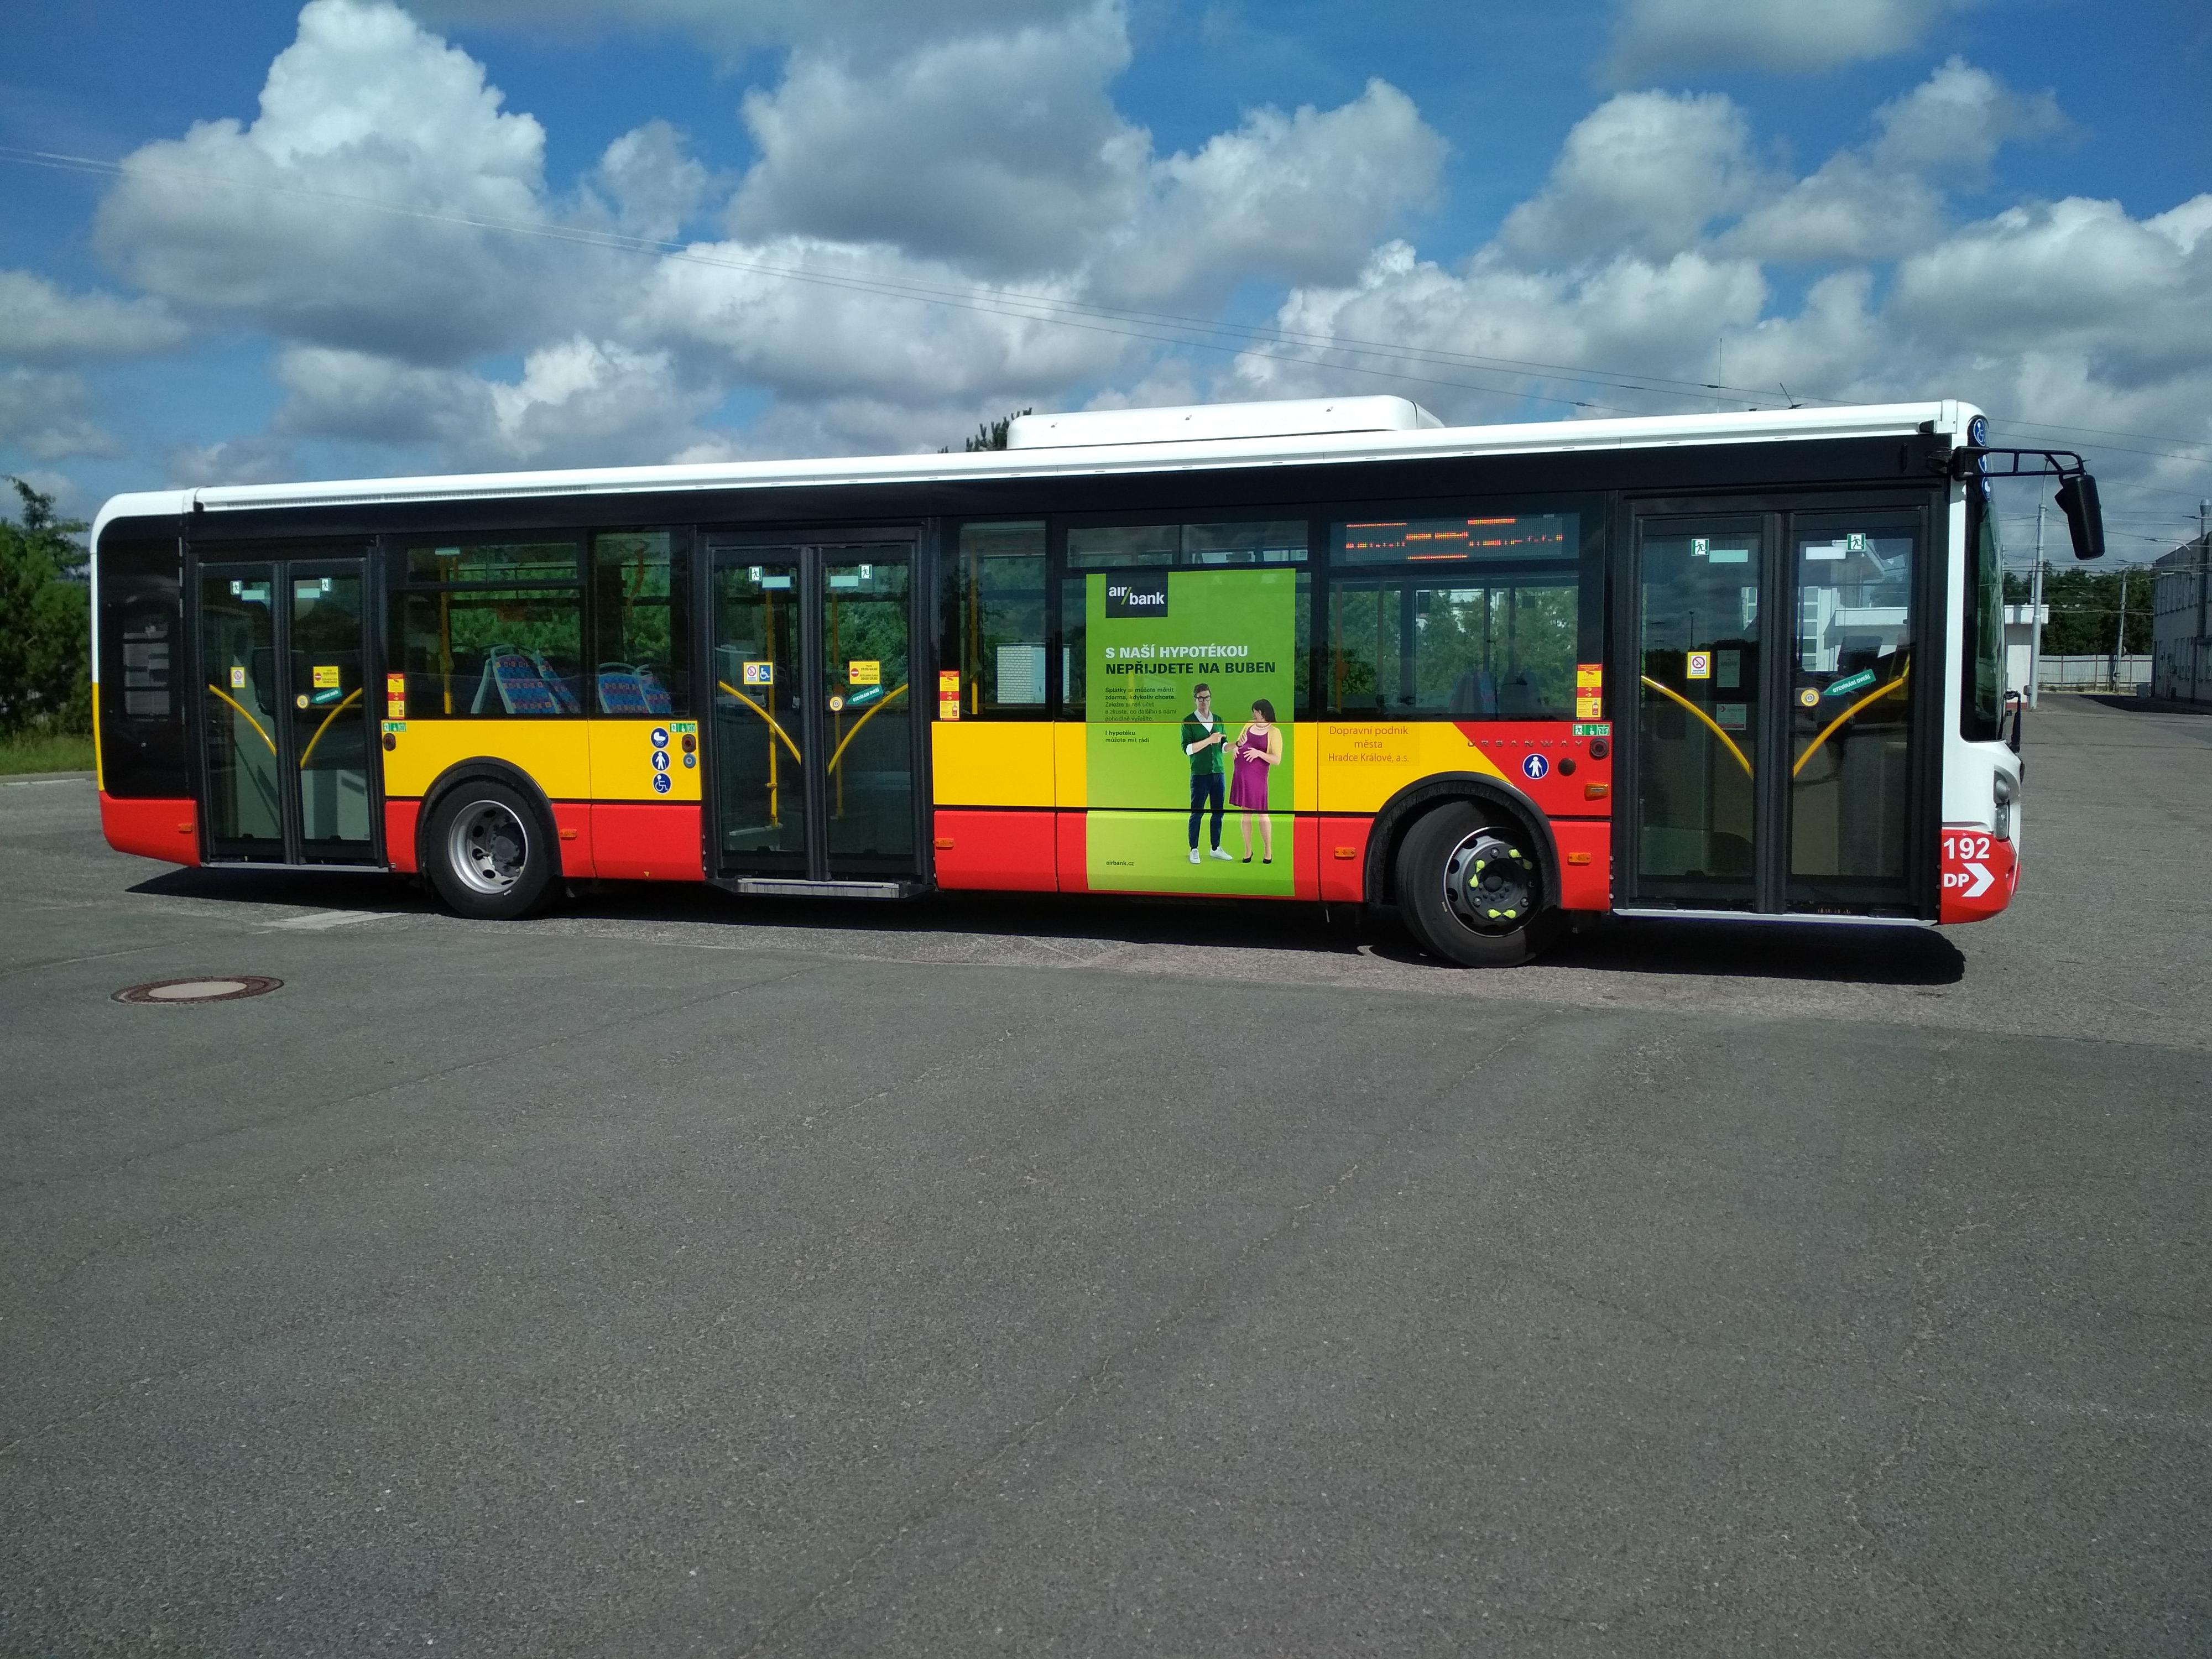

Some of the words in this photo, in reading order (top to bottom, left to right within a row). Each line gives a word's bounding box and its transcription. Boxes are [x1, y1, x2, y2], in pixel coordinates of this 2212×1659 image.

[1129, 592, 1165, 605] bank
[1105, 647, 1115, 658] S
[1120, 644, 1155, 658] NAŠÍ
[1160, 644, 1248, 658] HYPOTÉKOU
[1106, 661, 1193, 674] NEPŘIJDETE
[1199, 663, 1220, 673] NA
[1225, 662, 1275, 673] BUBEN
[1329, 726, 1373, 736] Dopravní
[1375, 726, 1408, 736] podnik
[1354, 739, 1383, 748] města
[1328, 753, 1358, 762] Hradce
[1360, 753, 1394, 763] Králové,
[1943, 837, 1990, 859] 192
[1943, 873, 1970, 888] DP
